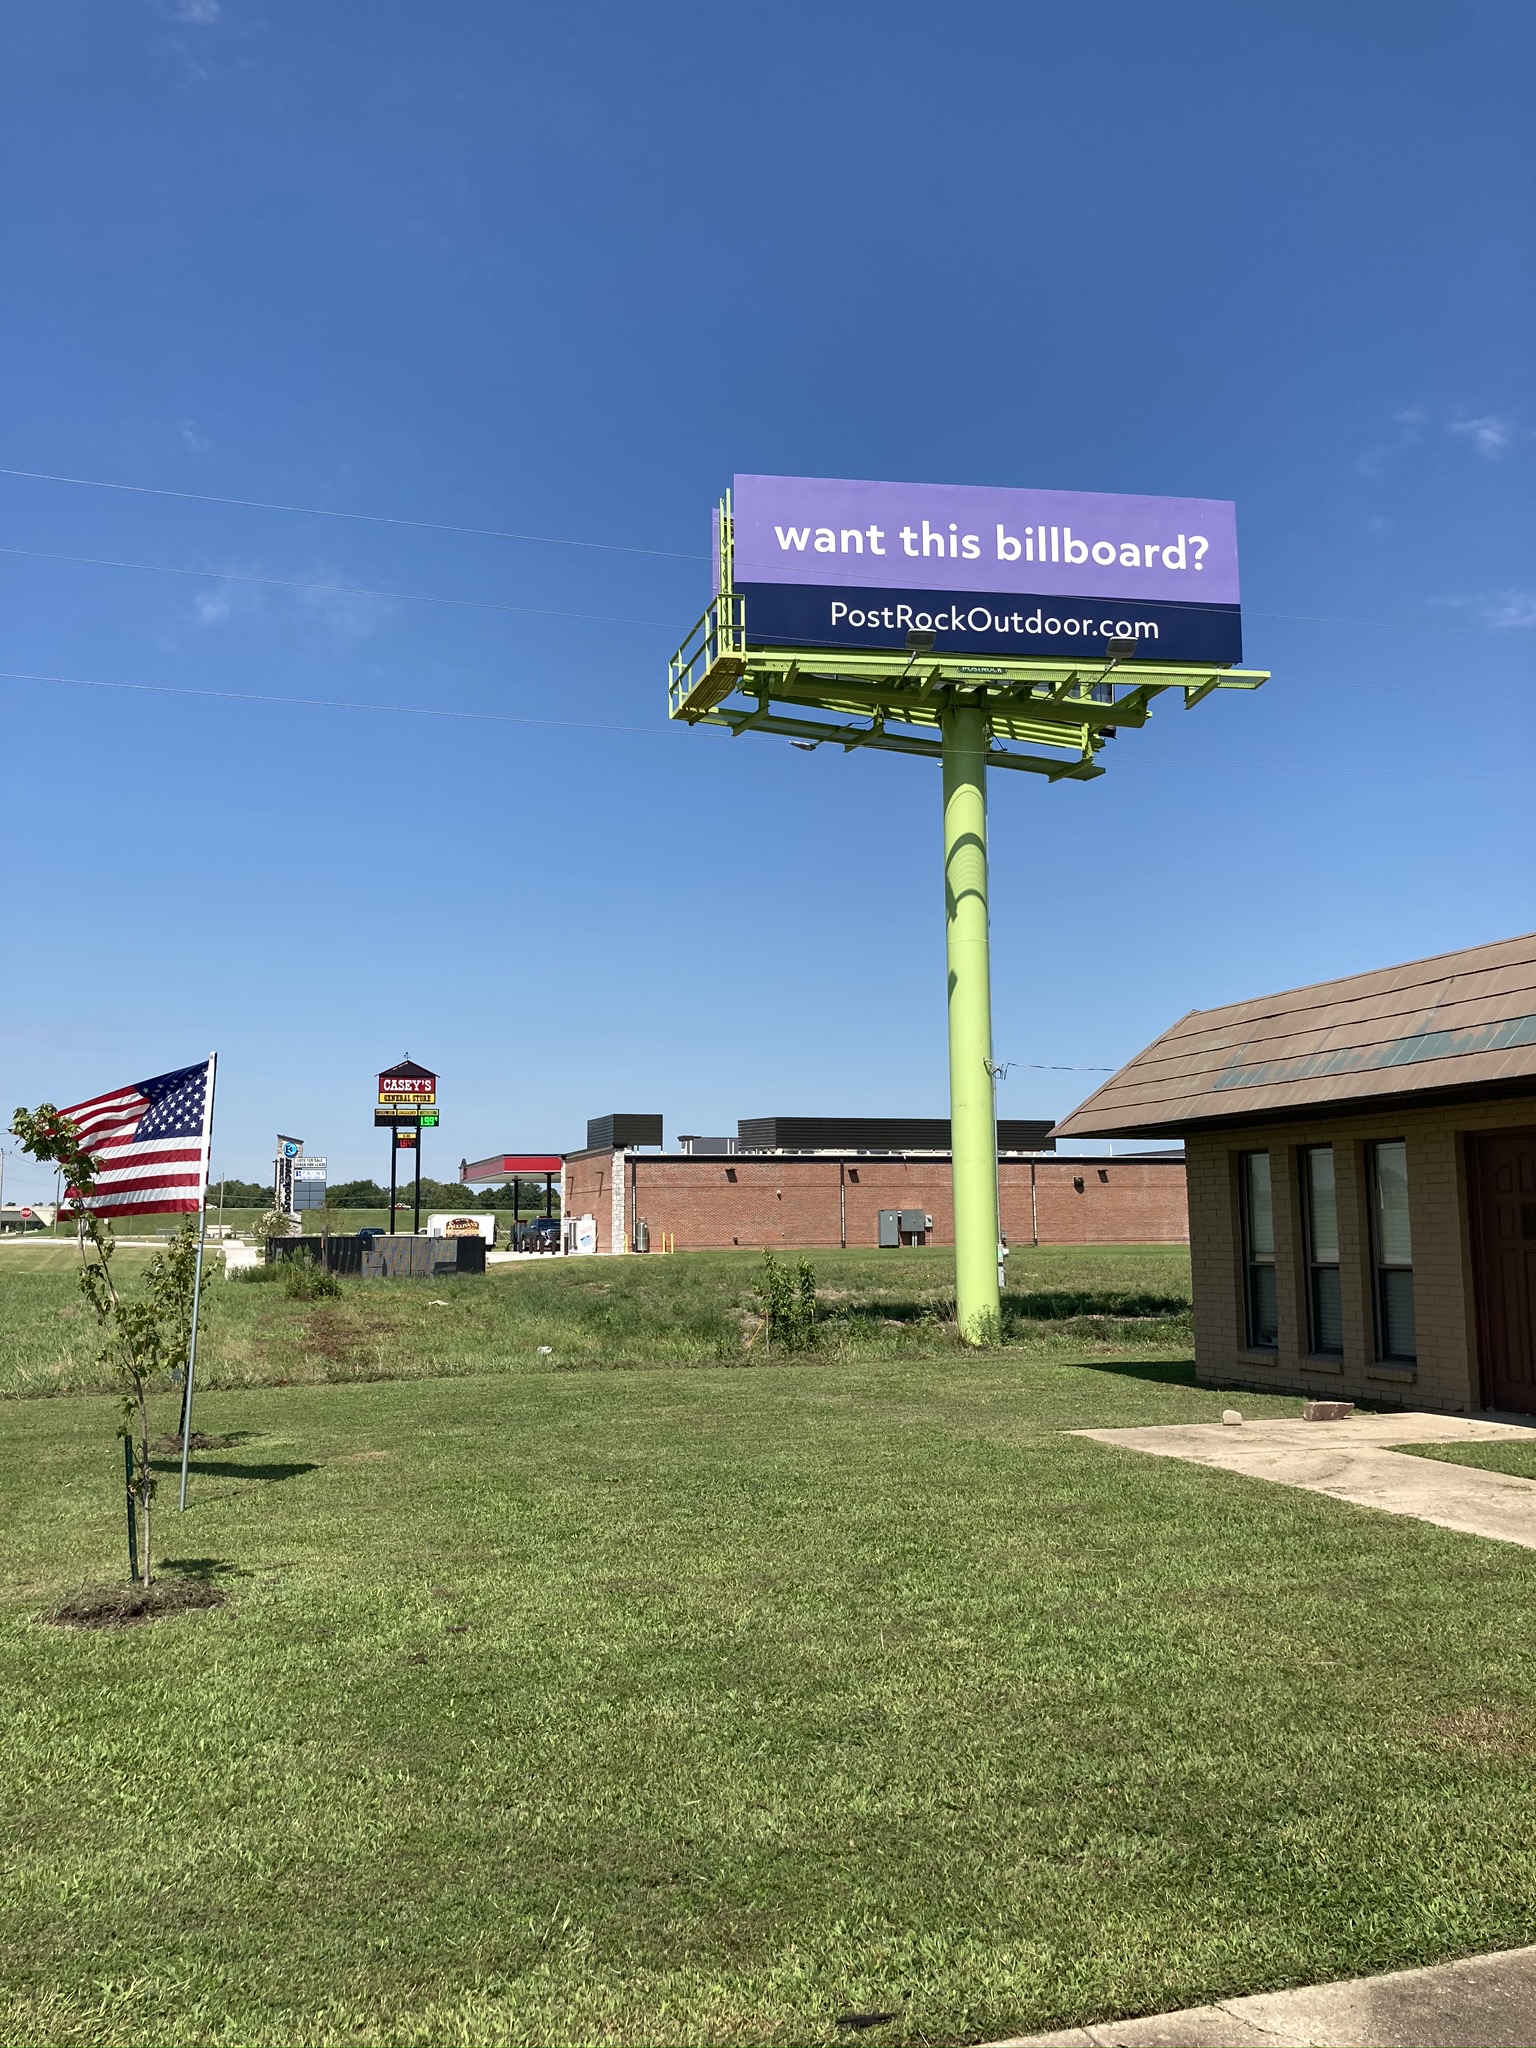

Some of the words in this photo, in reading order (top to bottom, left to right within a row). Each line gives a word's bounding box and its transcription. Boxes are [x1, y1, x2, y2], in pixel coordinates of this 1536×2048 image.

[774, 523, 886, 556] want
[899, 520, 981, 560] this
[997, 523, 1209, 571] billboard?
[831, 601, 1159, 640] PostRockOutdoor.com
[384, 1080, 432, 1092] CASEY'S
